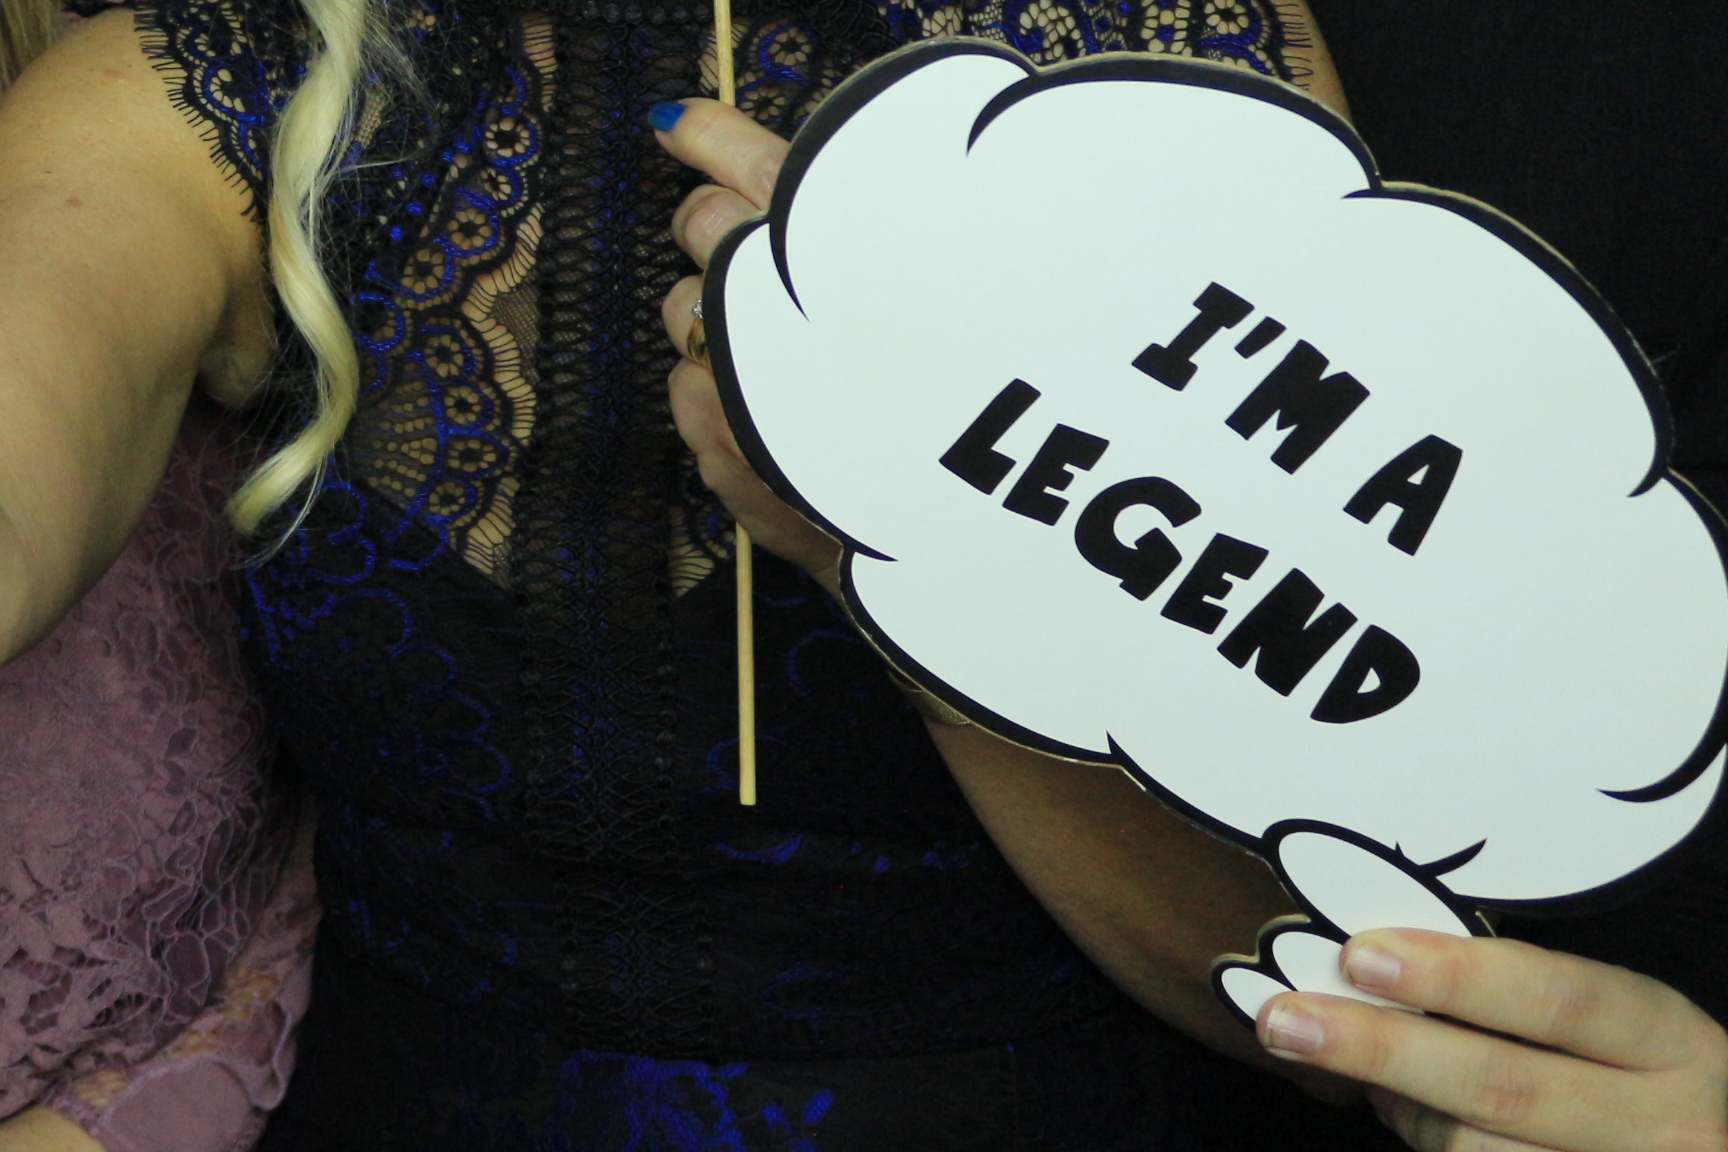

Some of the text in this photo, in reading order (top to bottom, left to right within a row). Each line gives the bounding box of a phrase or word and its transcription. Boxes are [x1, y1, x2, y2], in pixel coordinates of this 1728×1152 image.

[938, 377, 1422, 724] LEGEND
[1130, 281, 1464, 557] I'M A
